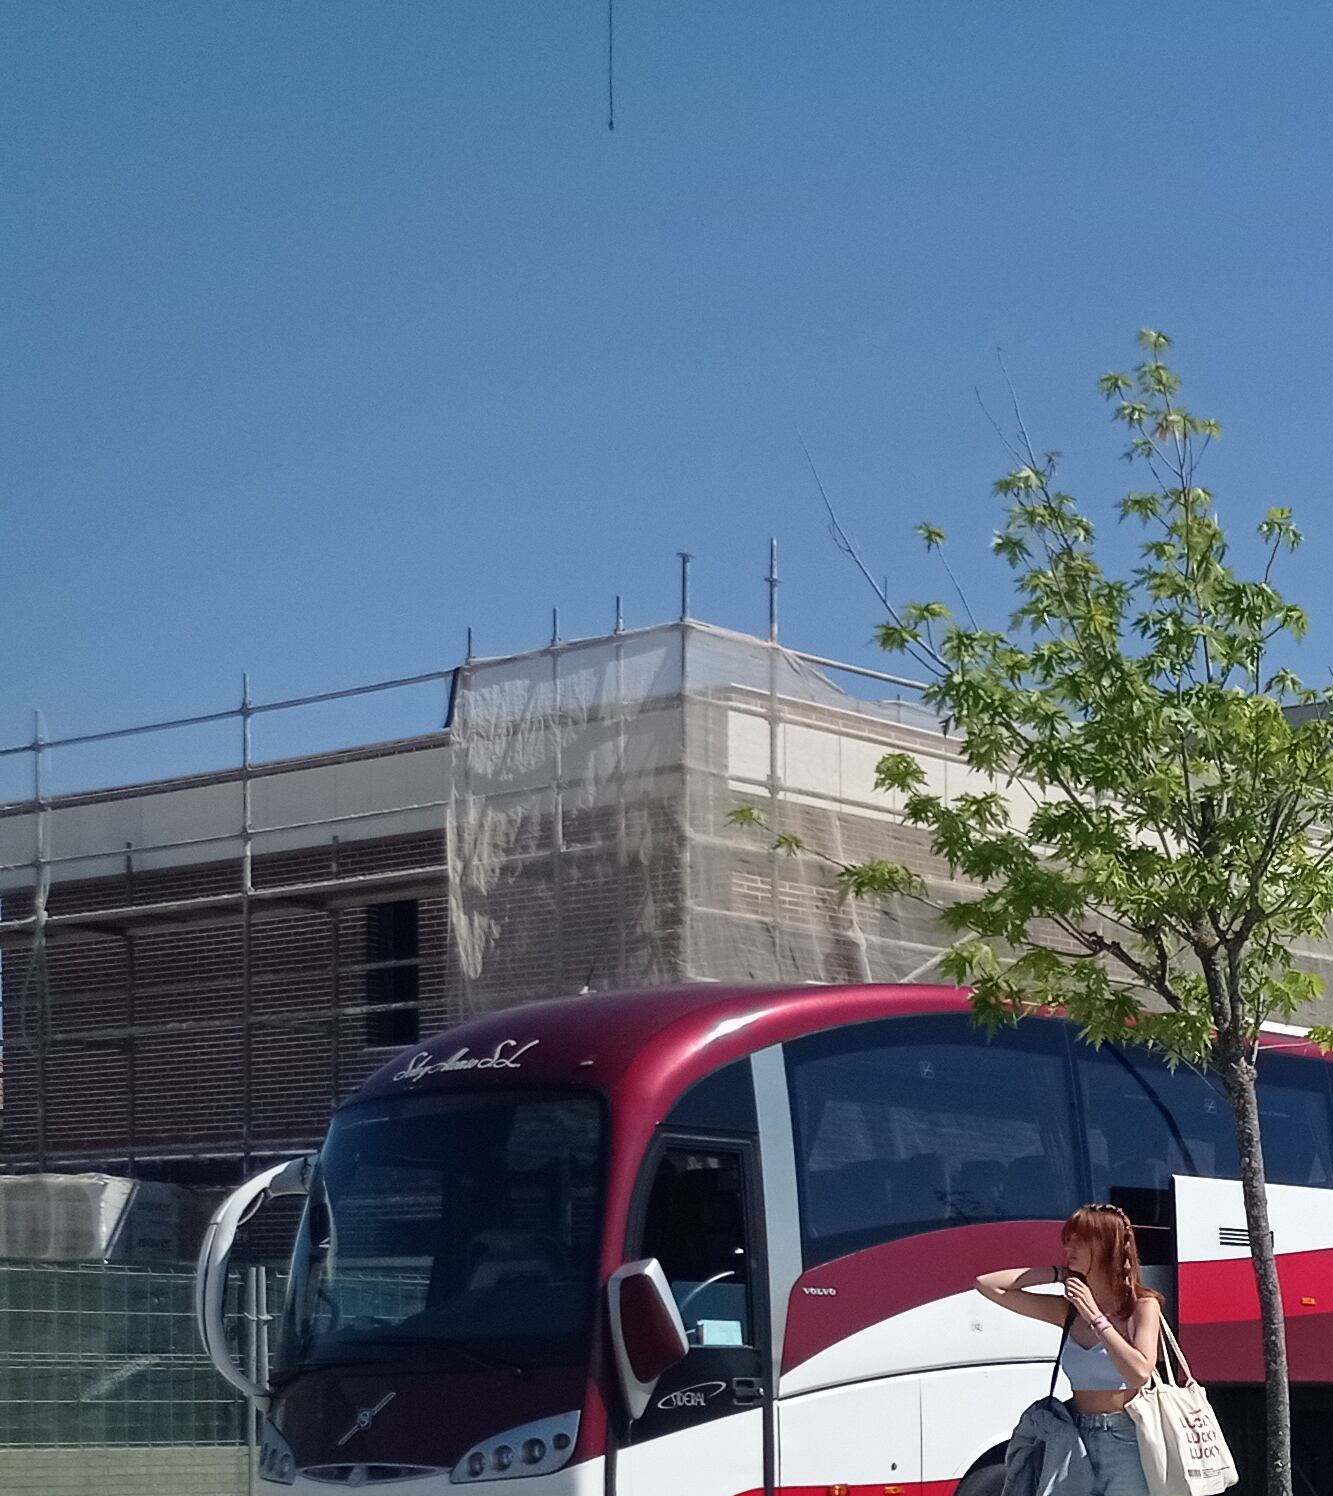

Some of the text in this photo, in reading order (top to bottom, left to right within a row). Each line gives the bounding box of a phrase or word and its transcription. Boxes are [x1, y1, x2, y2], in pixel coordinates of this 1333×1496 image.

[802, 1287, 837, 1296] VOLVO
[1185, 1430, 1217, 1444] LUCKY
[1190, 1445, 1220, 1460] LUCKY
